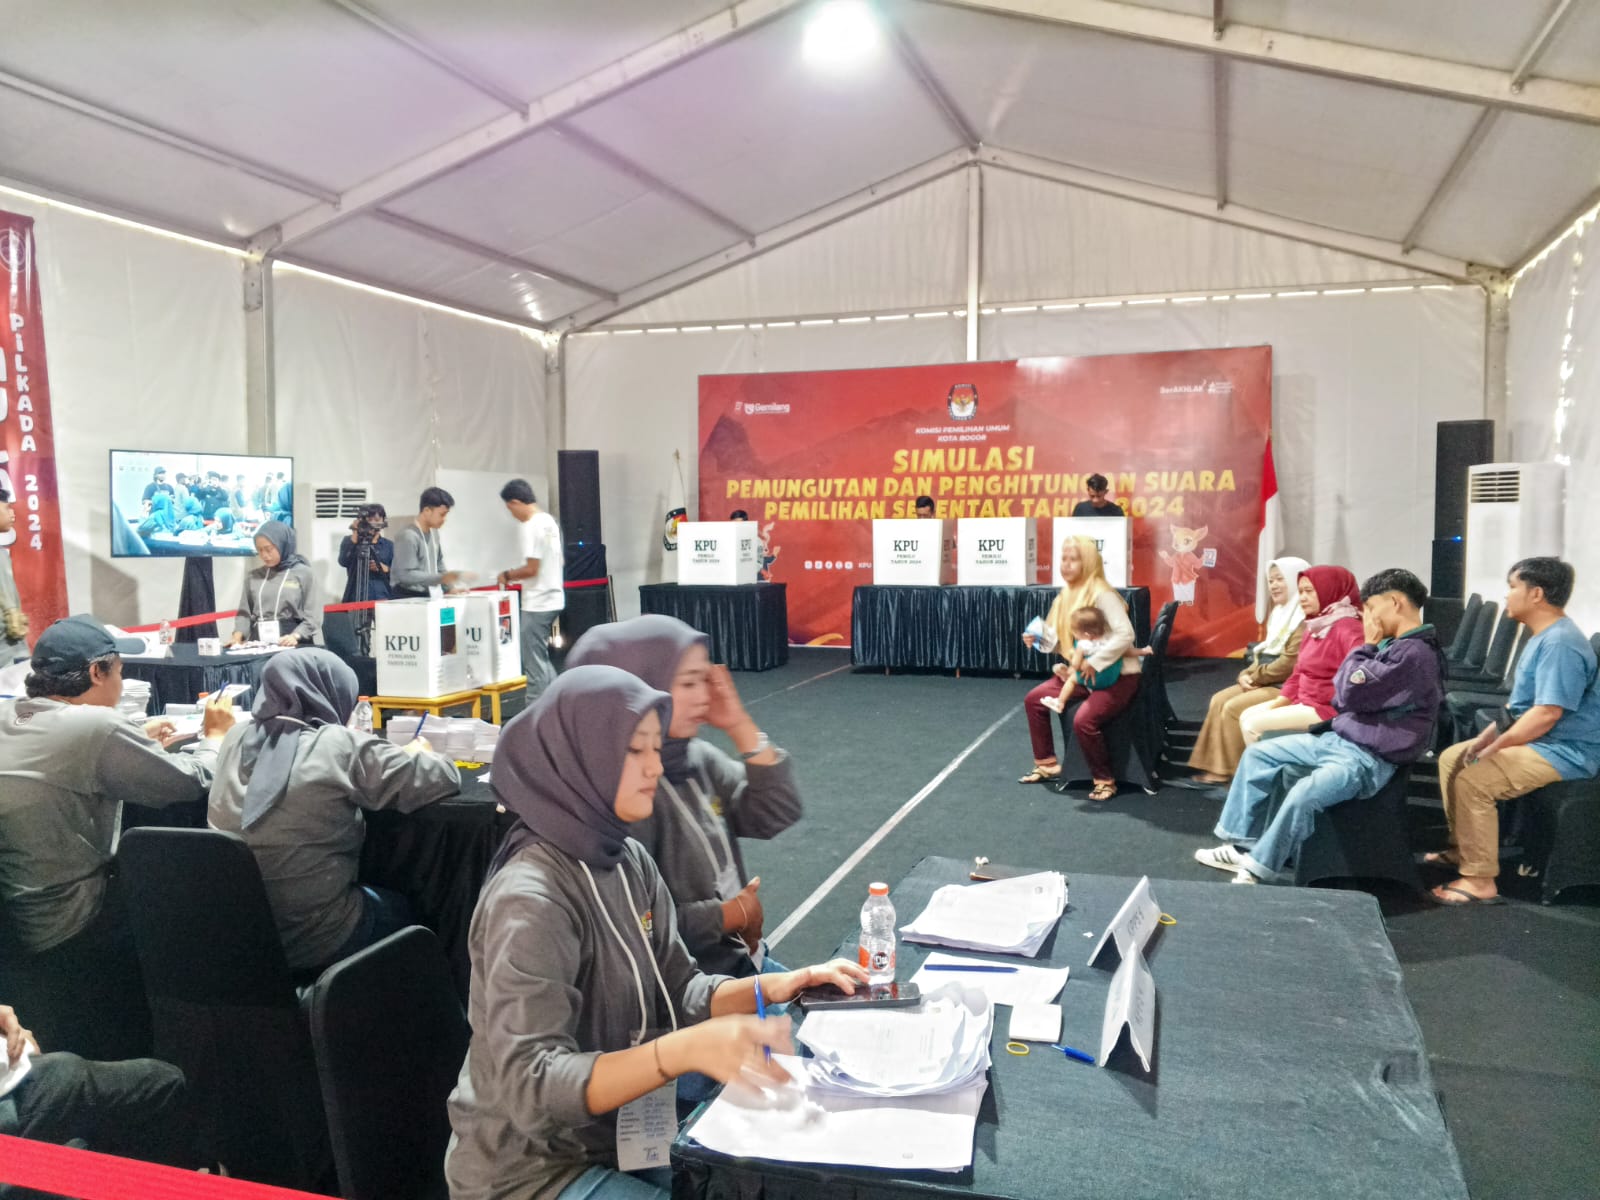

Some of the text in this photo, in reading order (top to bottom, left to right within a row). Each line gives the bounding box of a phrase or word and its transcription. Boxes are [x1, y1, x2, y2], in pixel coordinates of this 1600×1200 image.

[754, 402, 790, 413] Gemilang
[915, 424, 1011, 435] KOMISI PEMILIHAN UMUM
[937, 435, 958, 443] KOTA
[892, 446, 1035, 474] SIMULASI
[726, 477, 878, 498] PEMUNGUTAN
[883, 476, 933, 498] DAN
[1144, 469, 1236, 493] SUARA
[24, 474, 43, 551] 2024
[763, 500, 887, 521] PEMILIHAN
[891, 498, 1014, 520] SEENTAK
[1020, 497, 1091, 518] TAH
[694, 539, 717, 551] KPU
[894, 539, 919, 551] KPU
[978, 539, 1005, 551] KPU
[385, 635, 420, 652] KPU
